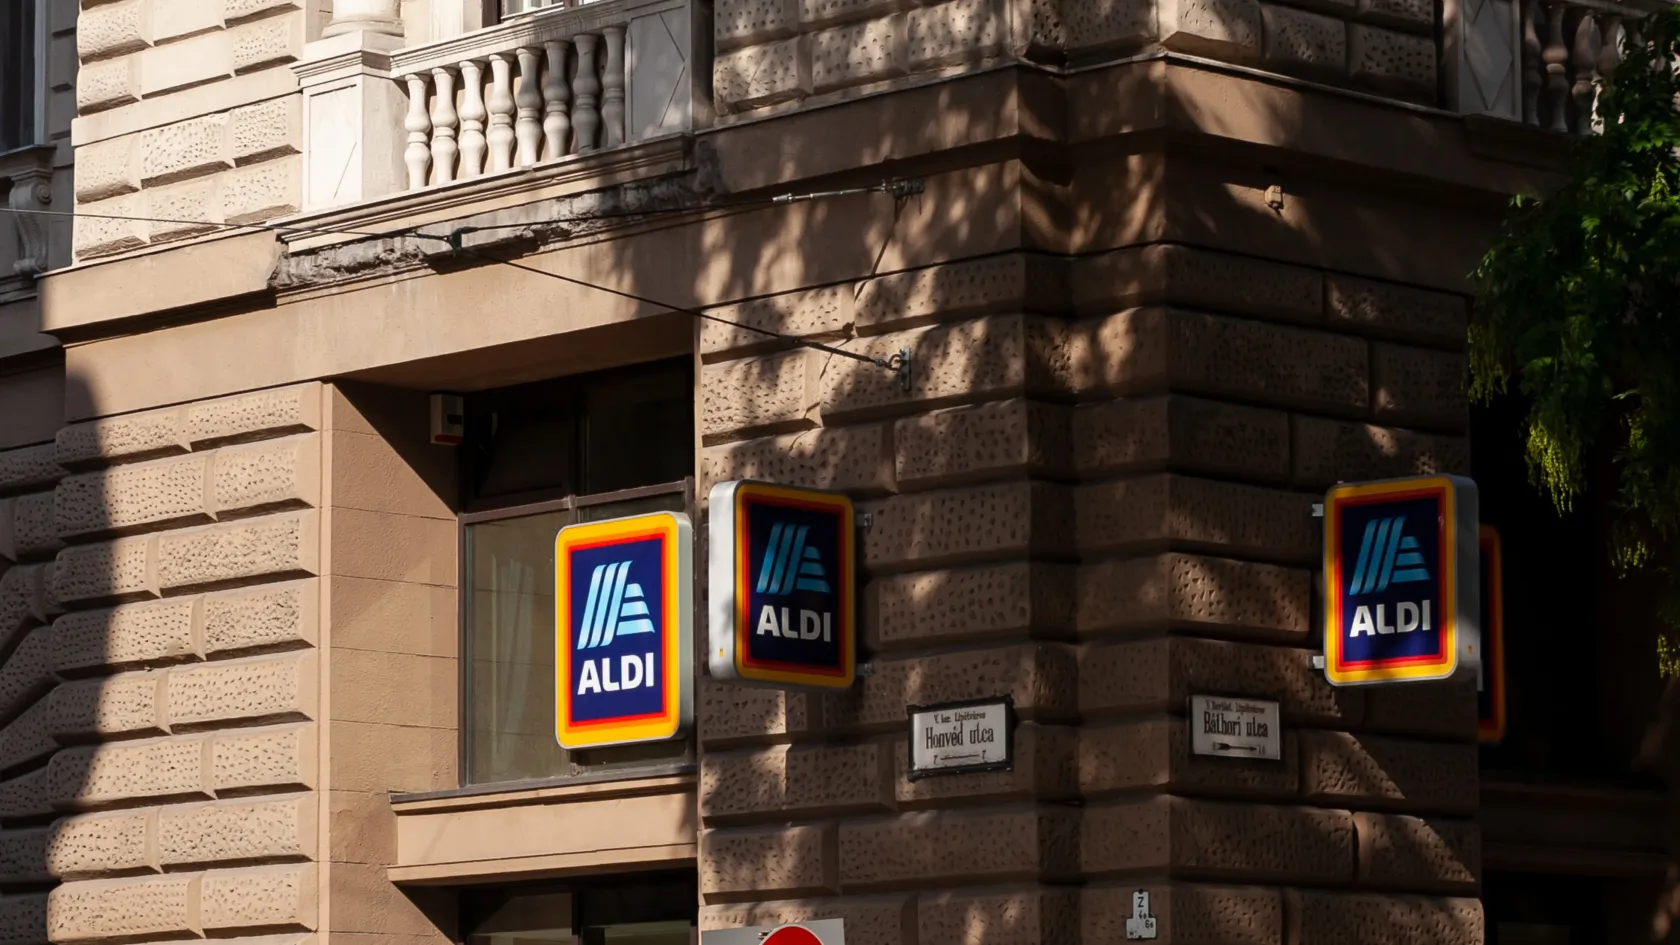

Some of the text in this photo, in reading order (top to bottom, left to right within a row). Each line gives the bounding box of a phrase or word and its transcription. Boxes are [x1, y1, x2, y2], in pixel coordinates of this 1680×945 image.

[756, 605, 832, 642] ALDI
[1350, 600, 1432, 637] ALDI
[577, 652, 655, 695] ALDI
[926, 721, 995, 750] Honvéd utca
[1203, 711, 1269, 738] Báthori utca
[1137, 896, 1145, 908] Z
